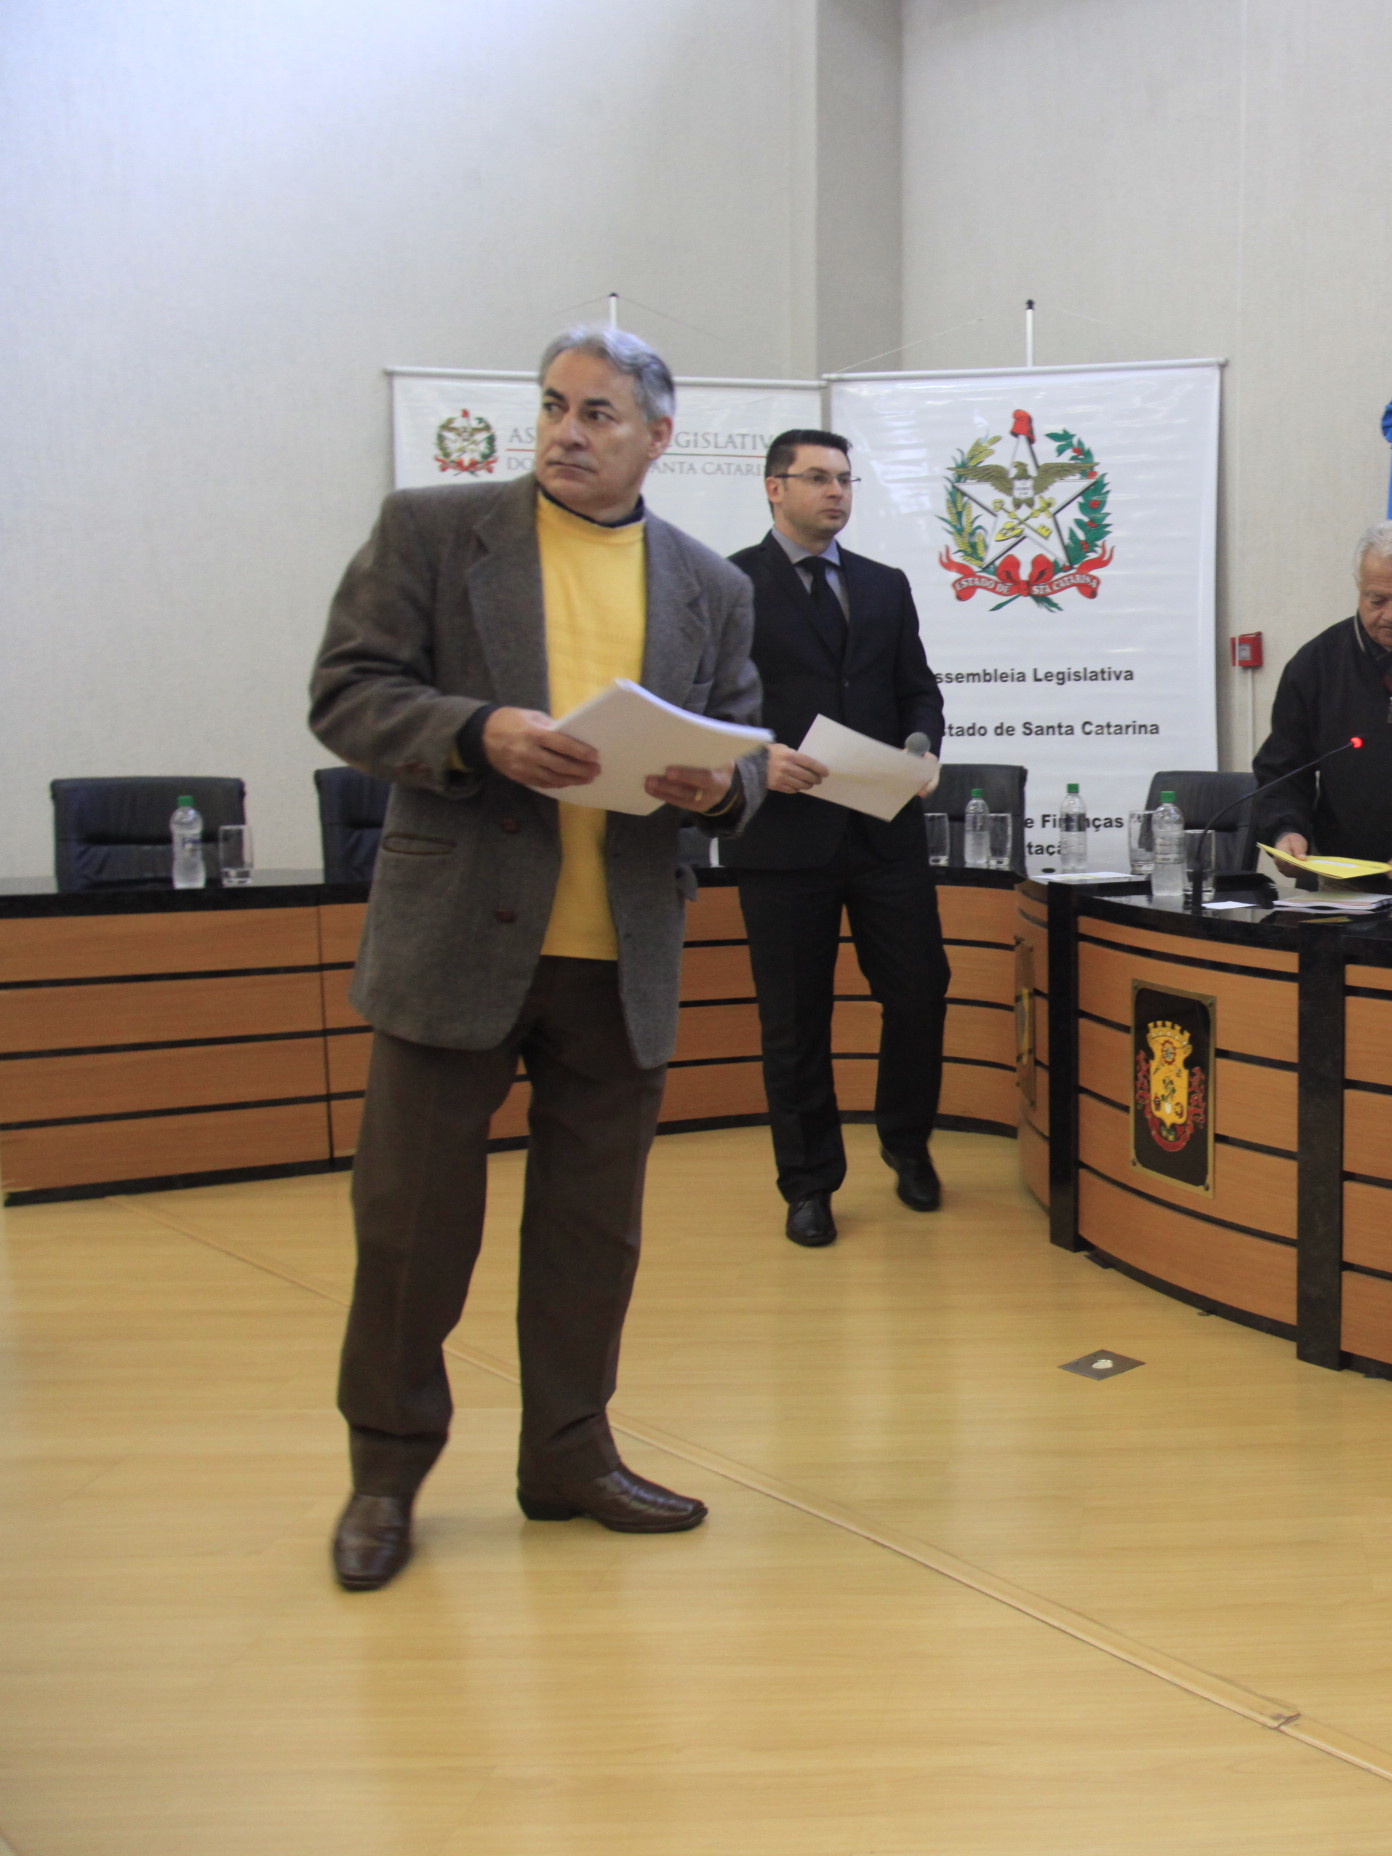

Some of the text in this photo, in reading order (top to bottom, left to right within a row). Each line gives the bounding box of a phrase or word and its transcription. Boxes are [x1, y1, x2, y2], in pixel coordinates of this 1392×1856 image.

[701, 462, 762, 476] CATARI
[935, 667, 1135, 685] ssembleia Legislativa
[994, 722, 1015, 737] de
[1022, 721, 1075, 737] Santa
[1081, 720, 1160, 736] Catarina
